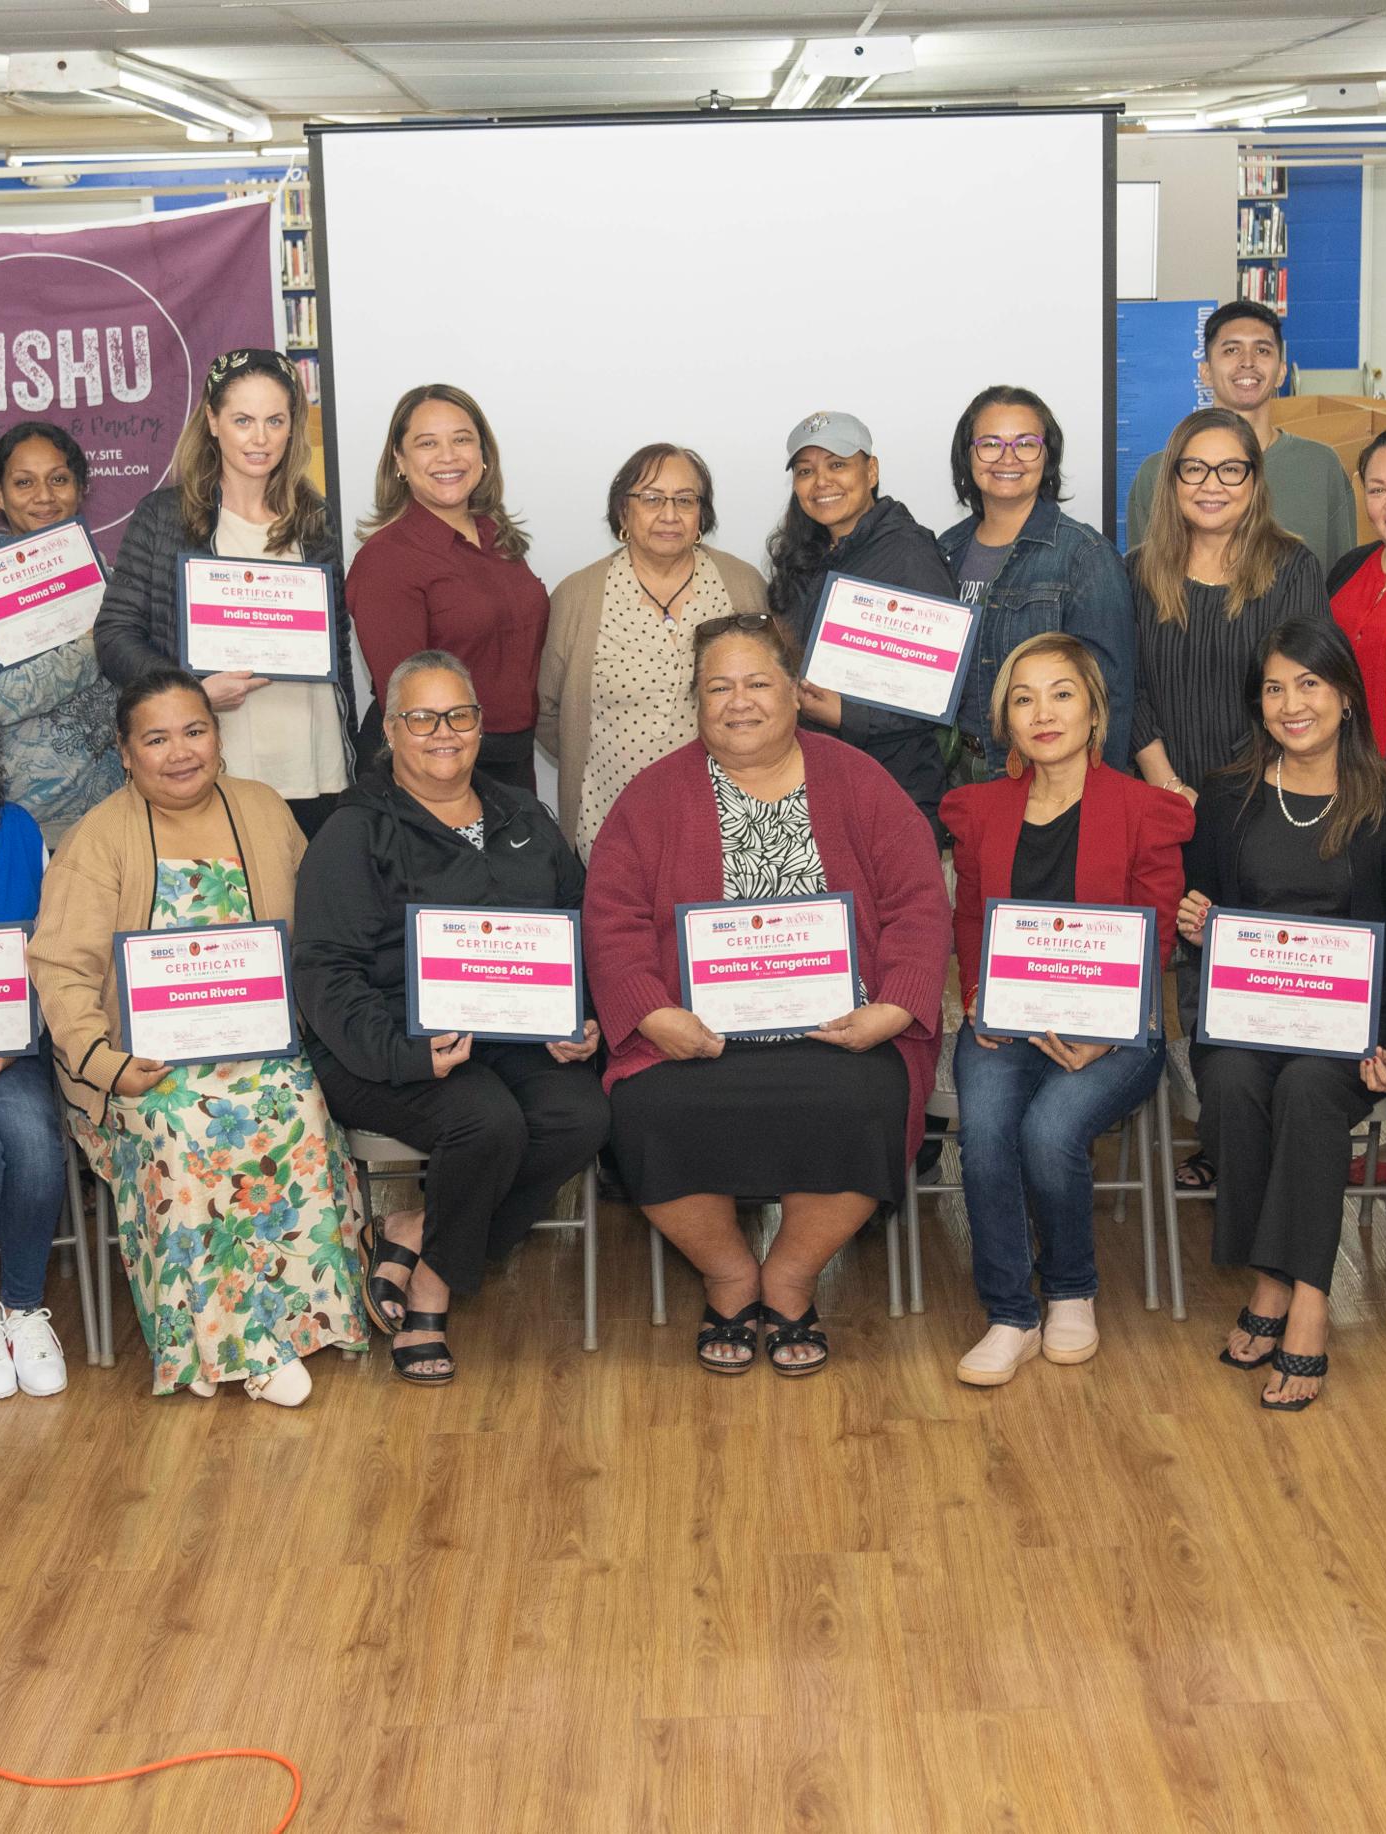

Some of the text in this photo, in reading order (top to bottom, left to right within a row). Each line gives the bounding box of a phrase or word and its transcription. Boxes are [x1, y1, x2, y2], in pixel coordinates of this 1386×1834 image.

[3, 555, 64, 584] CERTIFICATE
[18, 581, 66, 606] Danna Silo
[222, 587, 294, 600] CERTIFICATE
[224, 609, 293, 622] India Stauton
[861, 611, 933, 635] CERTIFICATE
[841, 632, 938, 663] Analee Villagomez
[727, 932, 810, 947] CERTIFICATE
[1027, 936, 1106, 950] CERTIFICATE
[1237, 931, 1261, 939] SBDC
[456, 940, 538, 951] CERTIFICATE
[710, 962, 748, 974] Denita
[751, 961, 762, 971] K.
[764, 955, 831, 972] Yangetmai
[1250, 948, 1333, 965] CERTIFICATE
[166, 958, 245, 974] CERTIFICATE
[462, 963, 533, 976] Frances Ada
[1027, 961, 1102, 978] Rosalia Pitpit
[1247, 973, 1333, 991] Jocelyn Arada
[169, 987, 247, 1002] Donna Rivera
